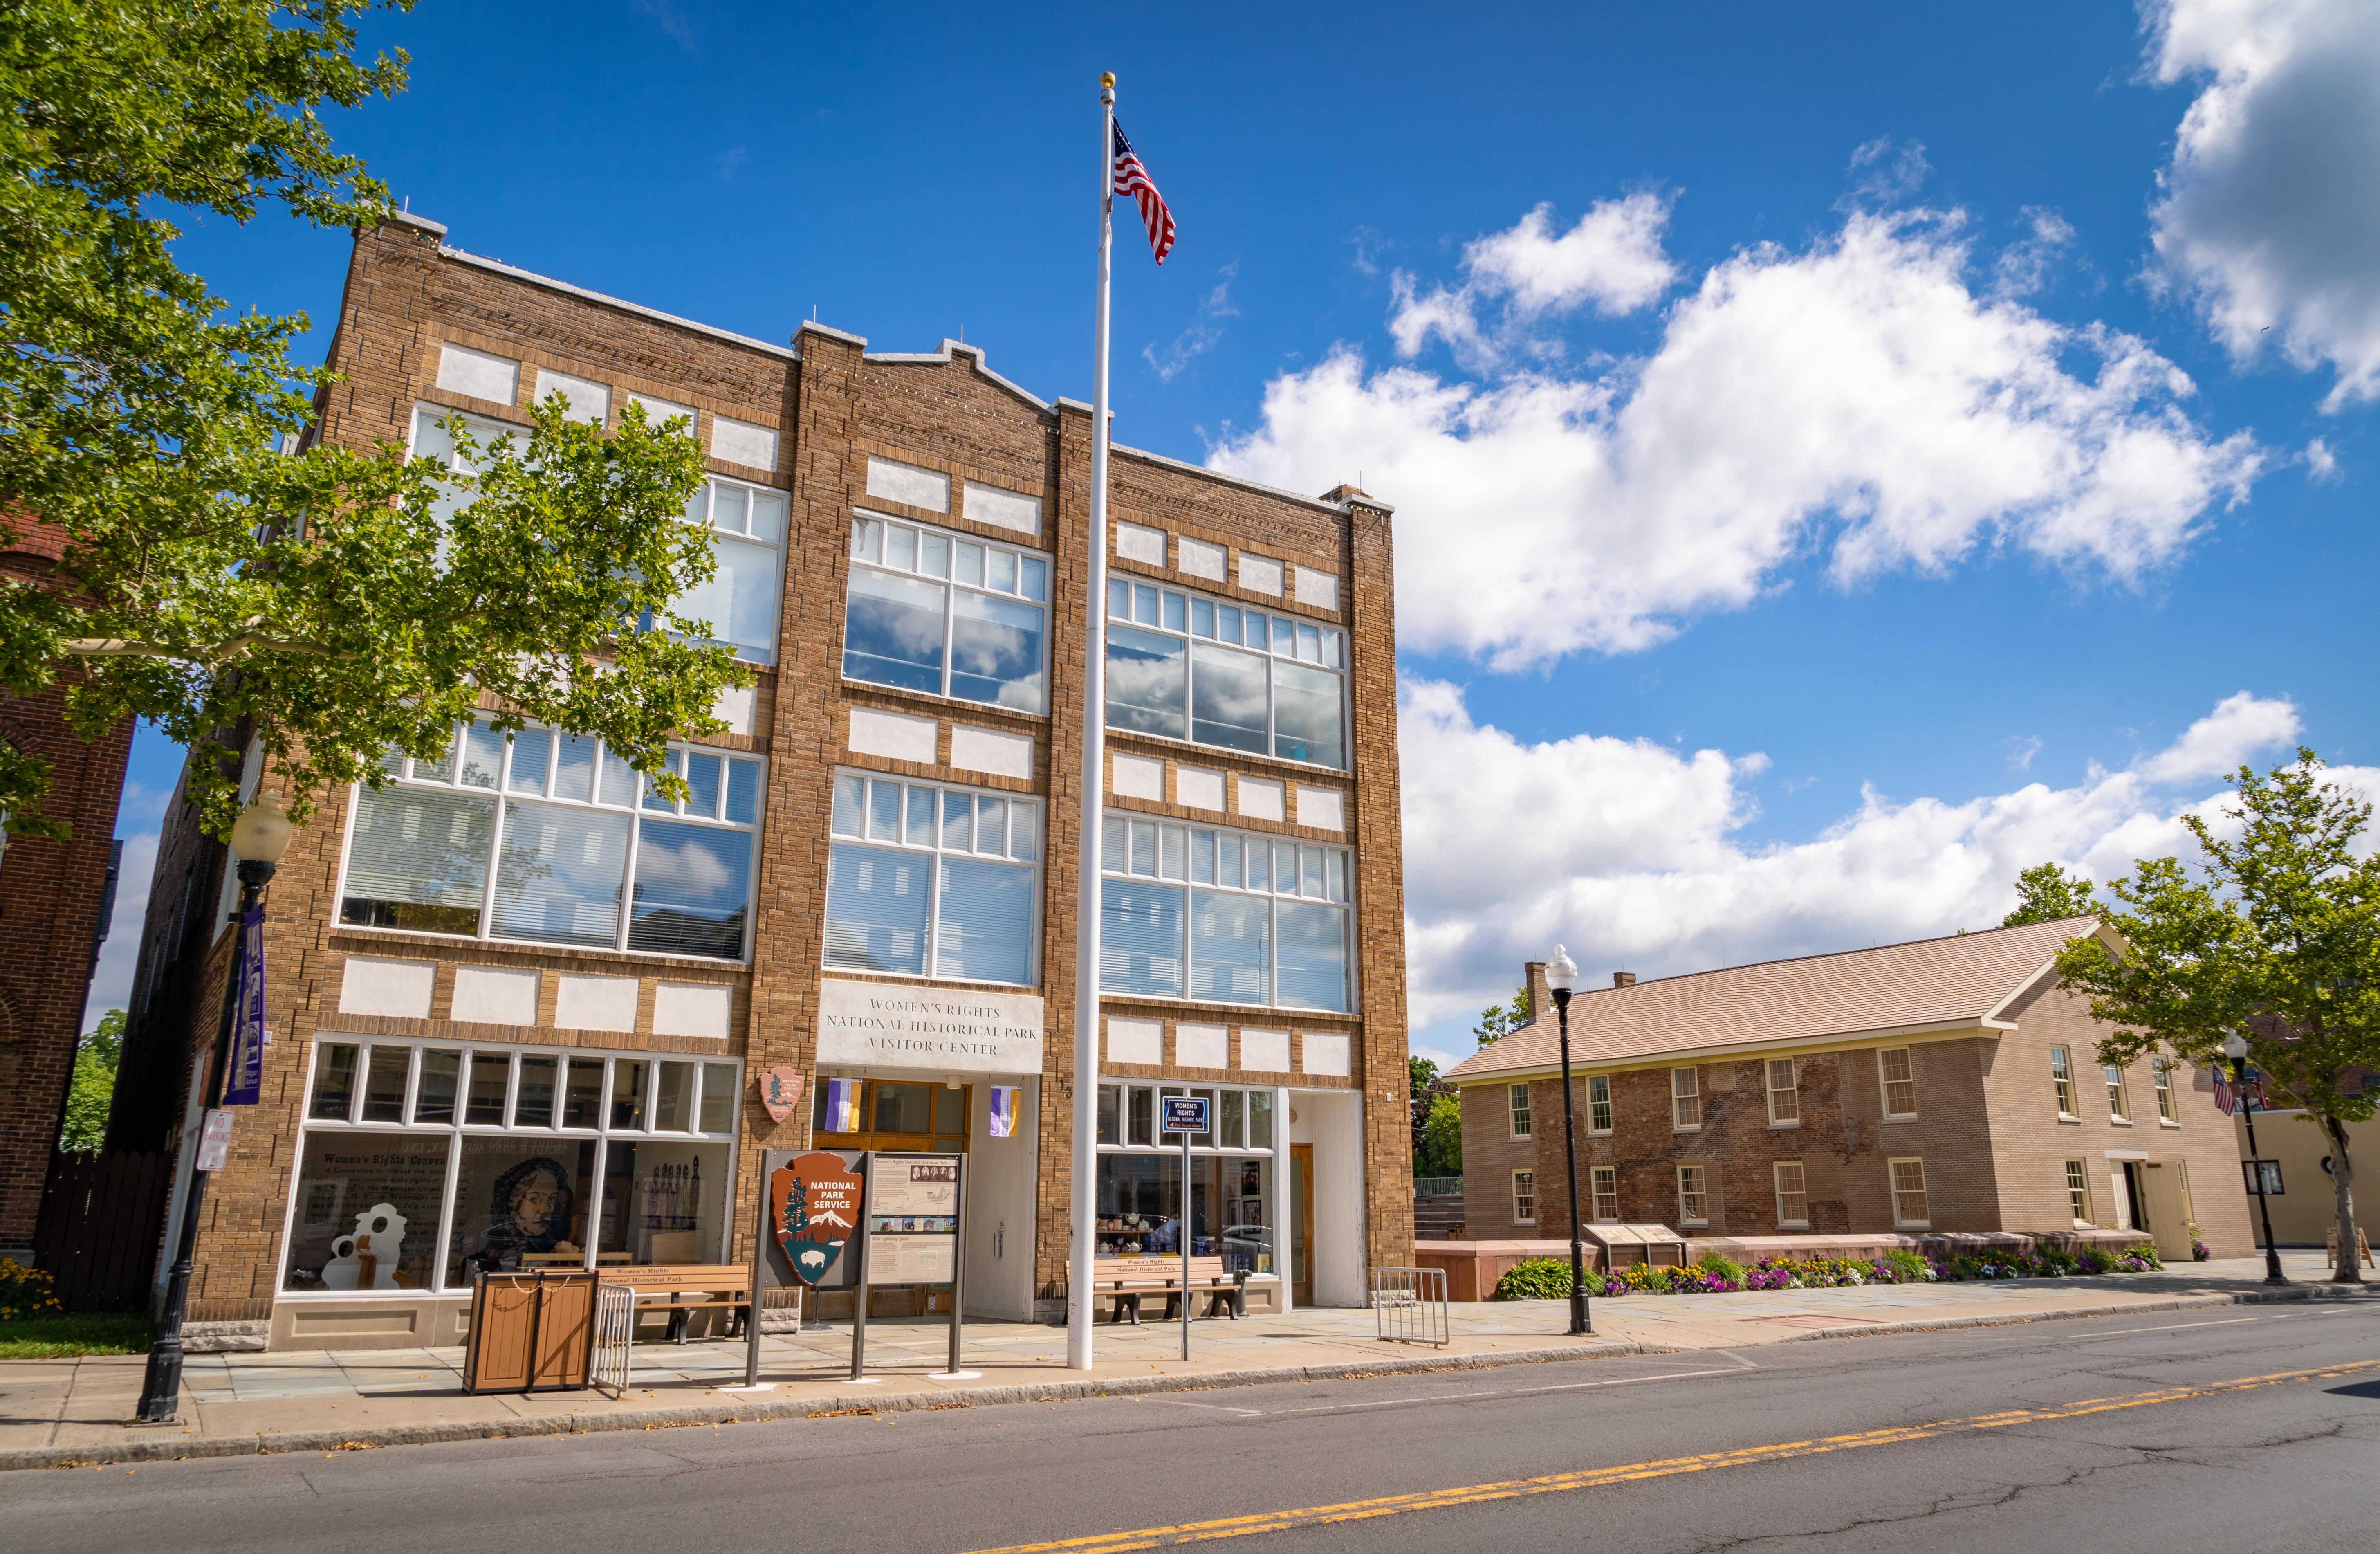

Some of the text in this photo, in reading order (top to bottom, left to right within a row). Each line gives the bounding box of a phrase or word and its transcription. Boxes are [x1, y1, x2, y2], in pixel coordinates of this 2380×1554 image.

[870, 999, 1000, 1018] WOMEN'S RIGHTS
[827, 1015, 1037, 1040] NATIONAL HISTORICAL PARK
[869, 1037, 997, 1055] VISITOR CENTER
[214, 1117, 224, 1128] NO
[204, 1130, 229, 1143] PARKING
[207, 1155, 219, 1163] TIME
[325, 1154, 369, 1164] Women's
[372, 1155, 405, 1166] Rights
[811, 1181, 856, 1190] NATIONAL
